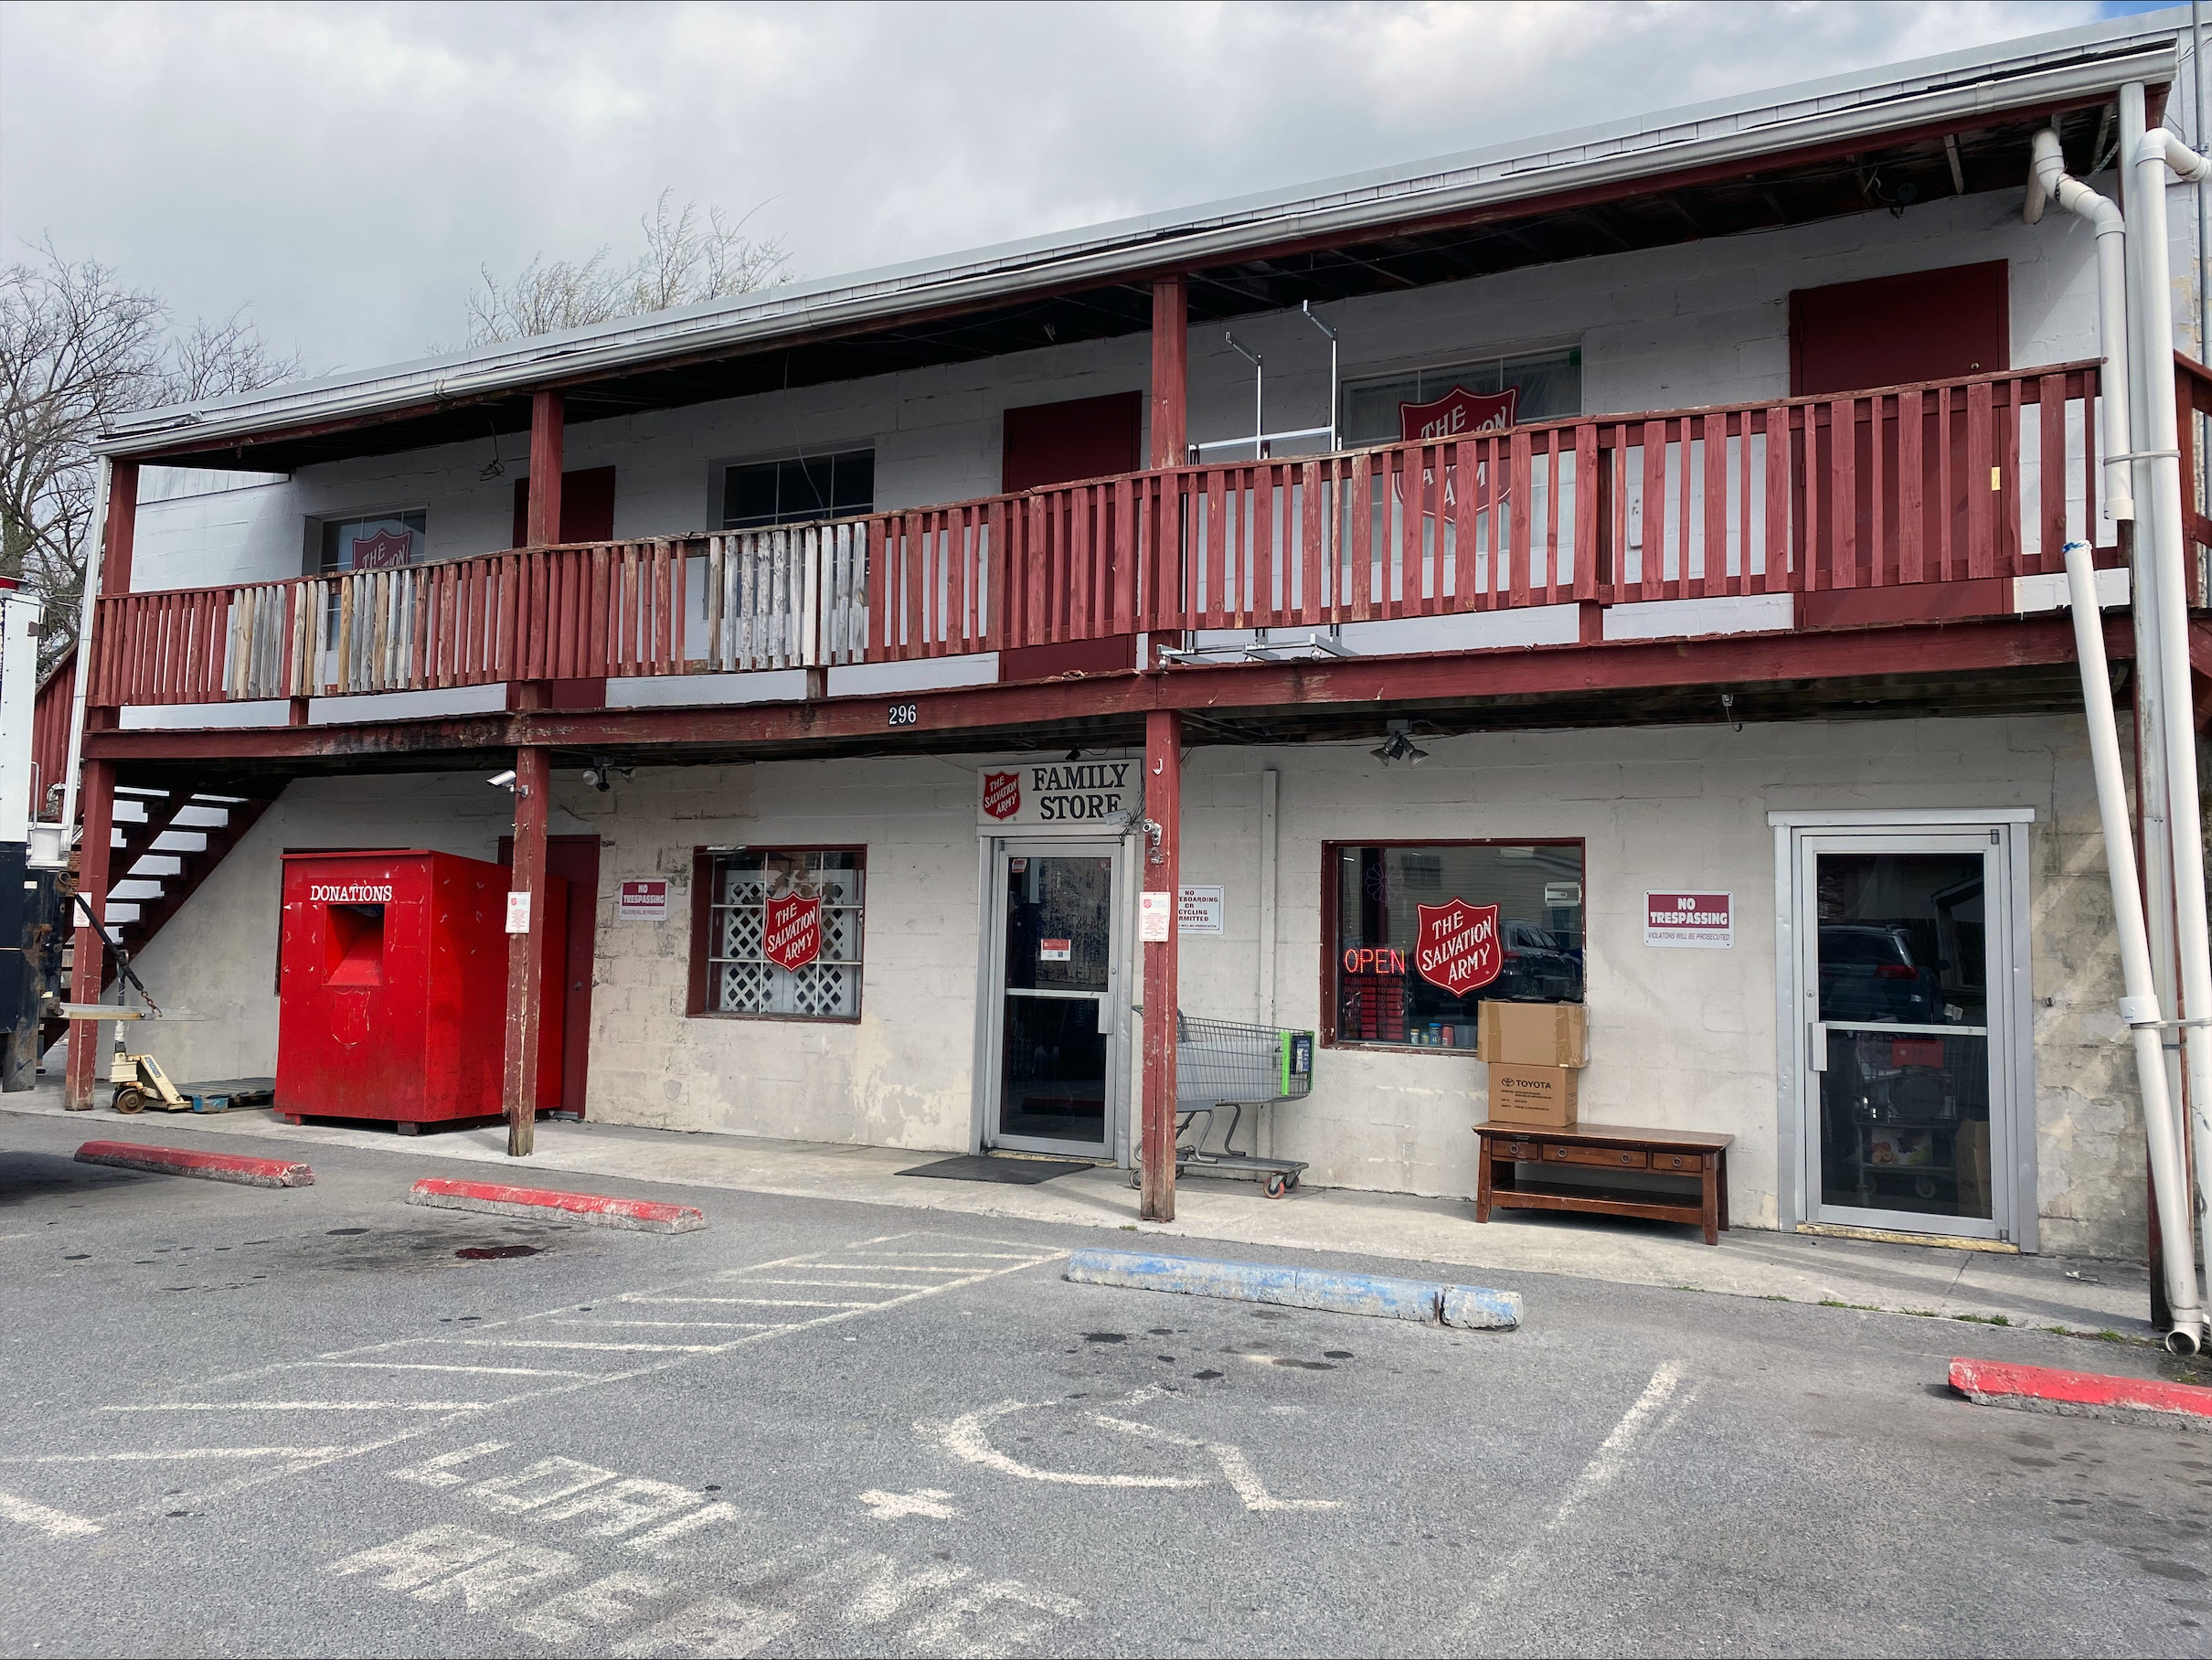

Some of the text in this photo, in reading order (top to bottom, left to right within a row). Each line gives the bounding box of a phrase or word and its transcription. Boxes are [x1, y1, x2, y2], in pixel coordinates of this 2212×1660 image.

[1420, 404, 1466, 439] THE
[362, 542, 386, 568] THE
[888, 704, 917, 725] 296
[989, 775, 1005, 793] THE
[1031, 763, 1130, 792] FAMILY
[984, 778, 1017, 809] SALVATION
[996, 792, 1017, 815] ARMY
[1040, 793, 1122, 820] STORE
[310, 885, 393, 902] DONATIONS
[622, 894, 665, 904] TRESPASSING
[637, 884, 649, 894] NO
[775, 901, 798, 928] THE
[1677, 898, 1696, 910] NO
[767, 906, 816, 953] SALVATION
[1432, 910, 1464, 941] THE
[1650, 911, 1728, 925] TRESPASSING
[783, 928, 814, 964] ARMY
[1422, 915, 1493, 972] SALVATION
[1648, 931, 1675, 940] VIOLATORS
[1344, 948, 1406, 974] OPEN
[1447, 942, 1491, 985] ARMY
[1344, 976, 1404, 986] BUSINESS HOURS
[1515, 1080, 1552, 1090] TOYOTA
